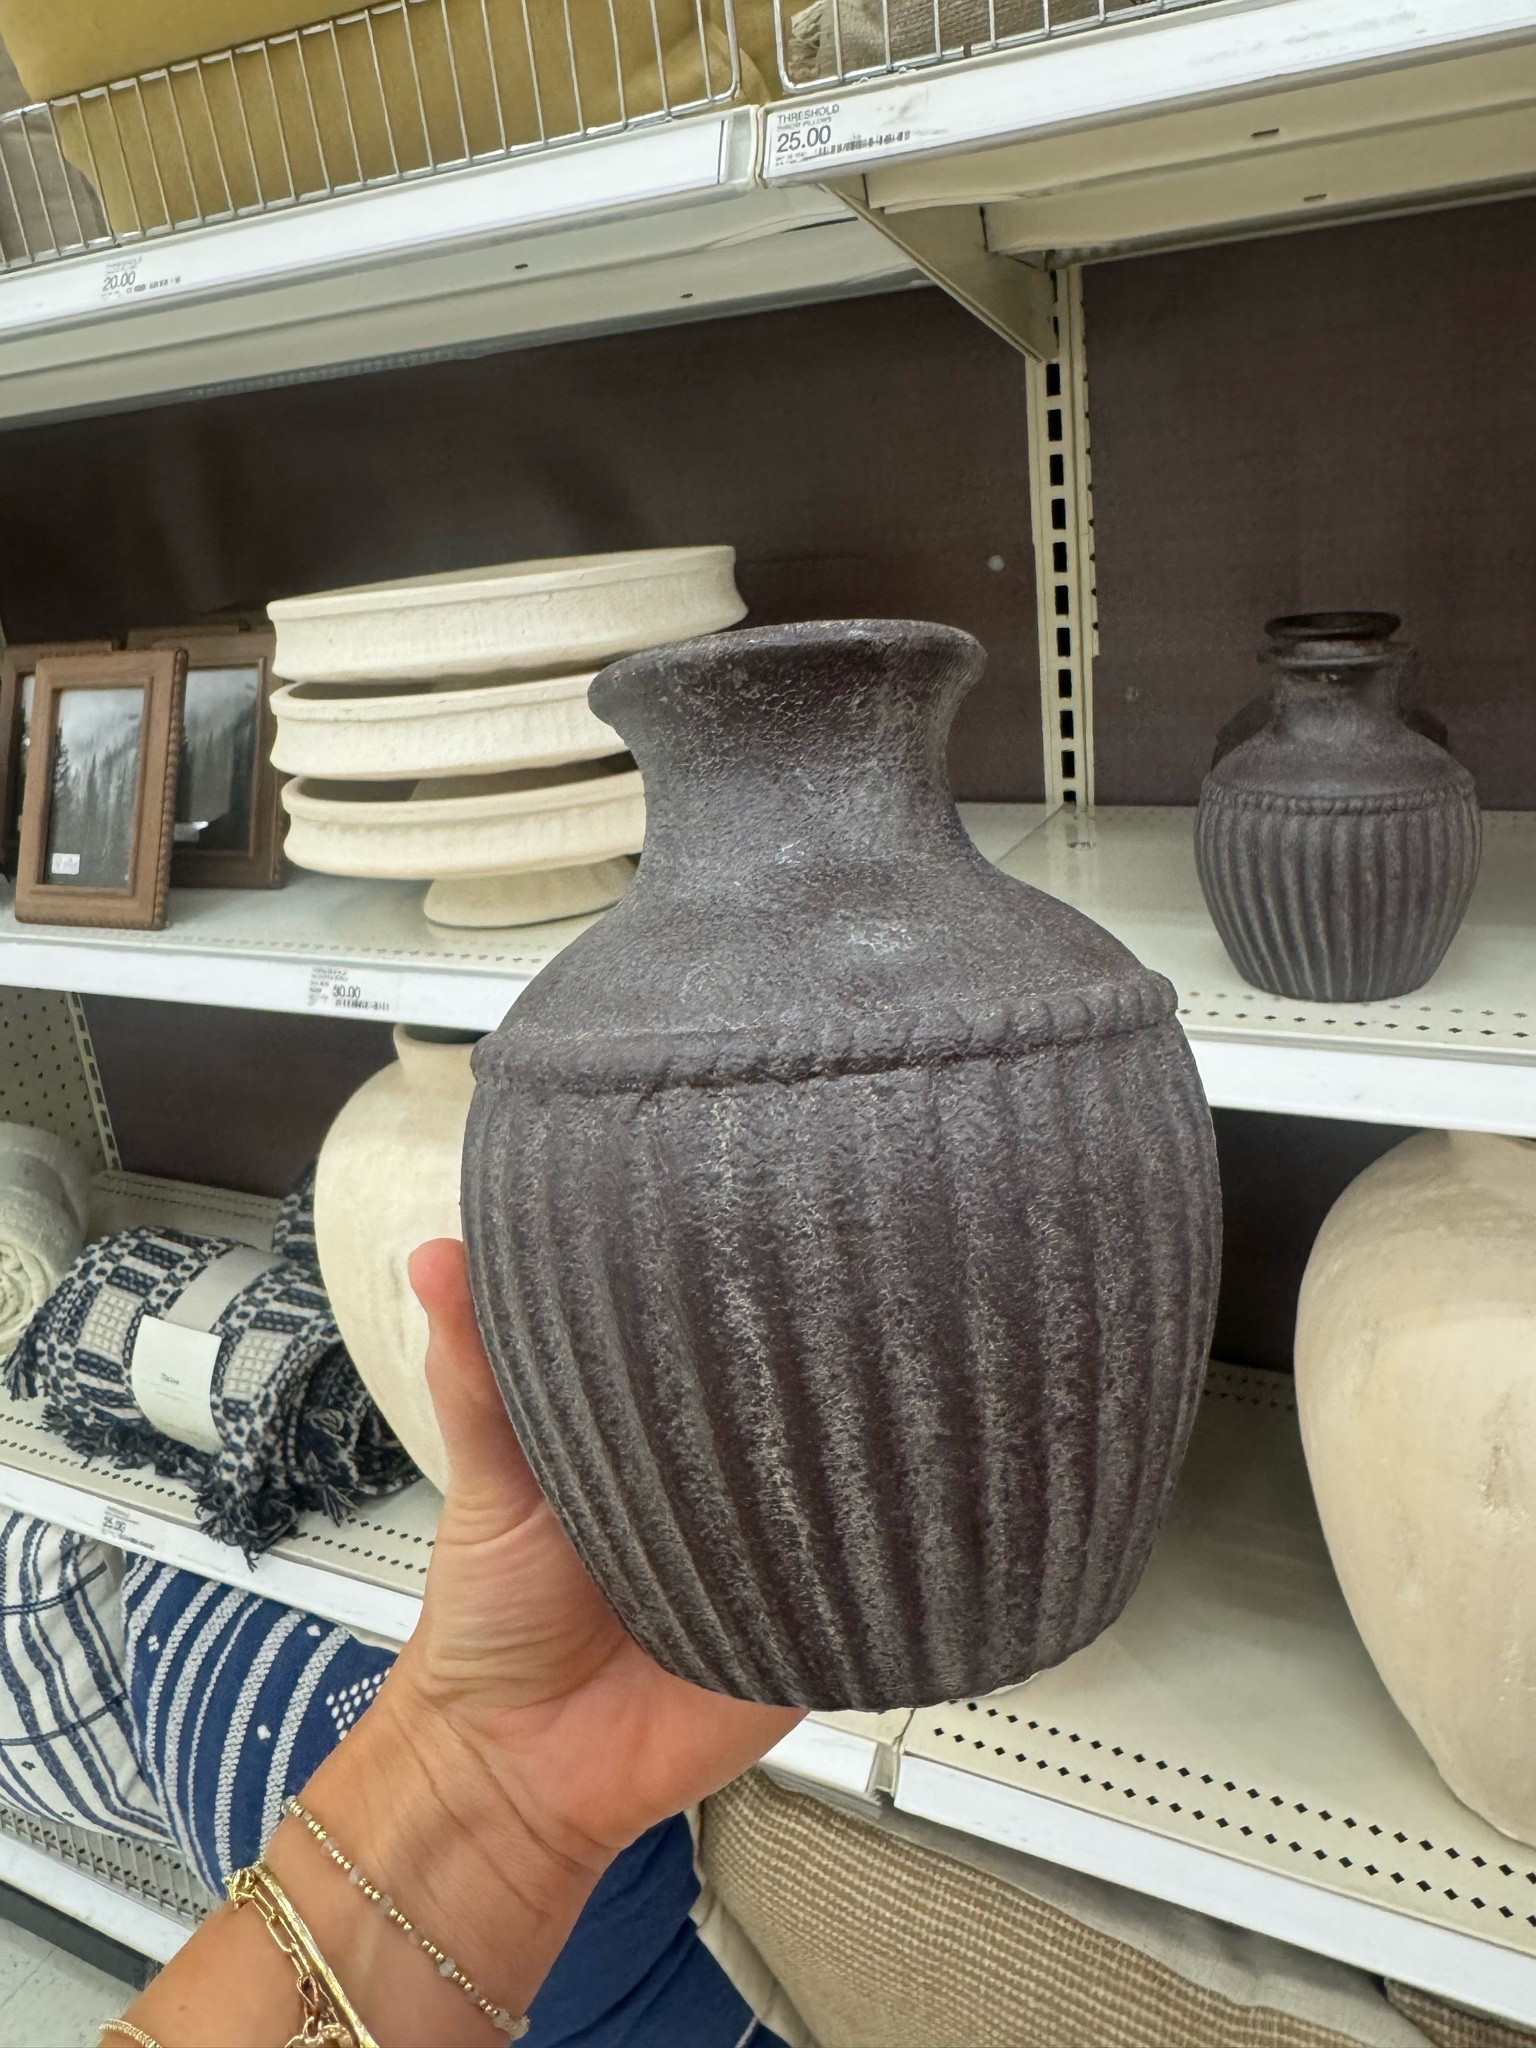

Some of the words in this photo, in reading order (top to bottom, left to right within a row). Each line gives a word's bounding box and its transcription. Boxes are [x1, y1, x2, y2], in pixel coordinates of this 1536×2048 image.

[777, 103, 840, 124] THRESHOLD
[776, 124, 832, 153] 25.00
[102, 270, 136, 292] 20.00
[333, 984, 361, 999] 30.00
